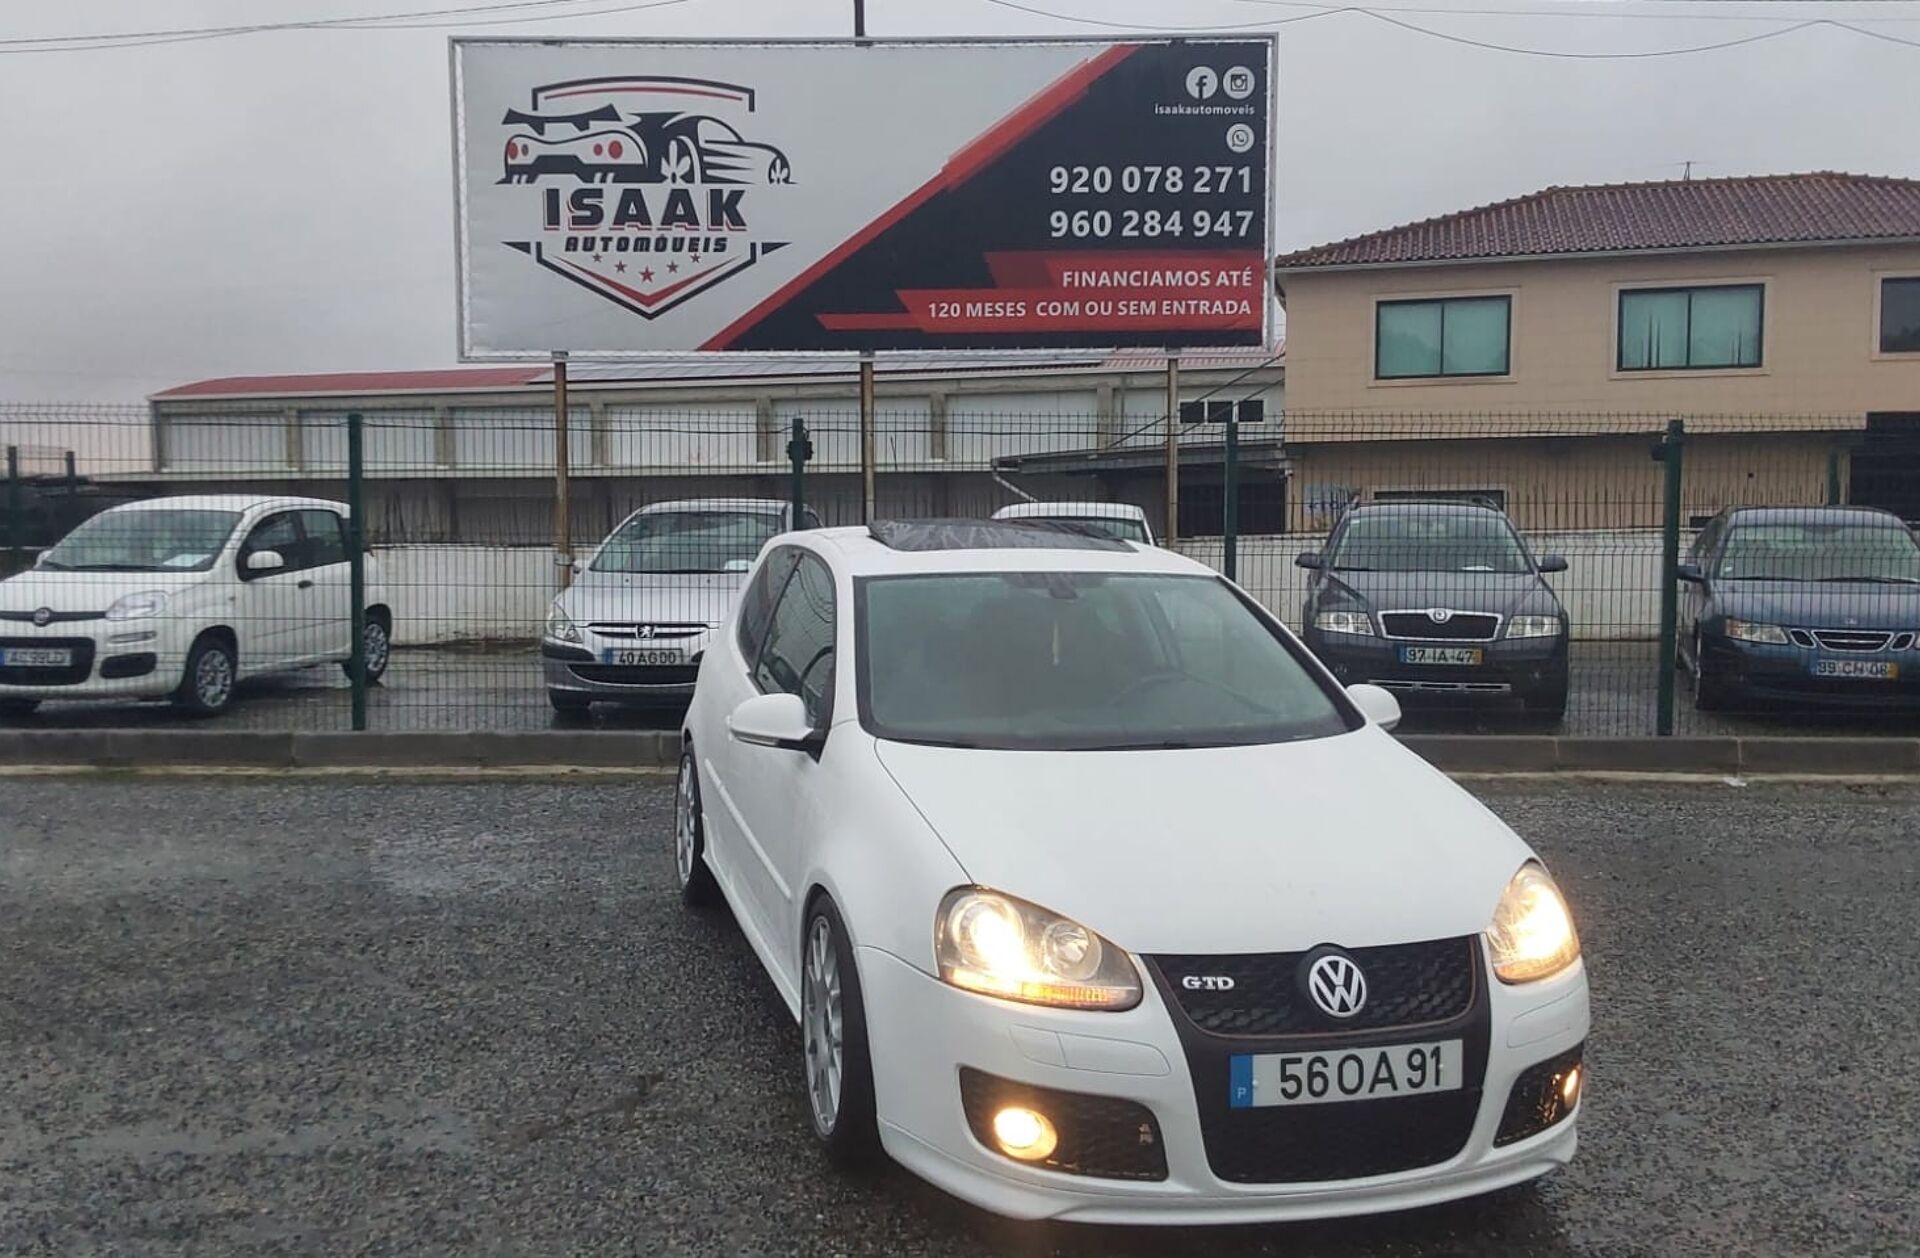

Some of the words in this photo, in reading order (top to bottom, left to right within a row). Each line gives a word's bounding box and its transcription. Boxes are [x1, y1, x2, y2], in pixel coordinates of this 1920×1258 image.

[1154, 104, 1255, 115] isaakautomoveis
[1049, 166, 1112, 193] 920
[1121, 166, 1183, 193] 078
[1193, 166, 1251, 193] 271
[543, 188, 748, 231] ISAAK
[1050, 210, 1112, 237] 960
[1121, 210, 1183, 237] 284
[1192, 210, 1254, 237] 947
[1062, 271, 1211, 287] FINANCIAMOS
[1215, 267, 1252, 286] ATÉ
[928, 303, 961, 318] 120
[966, 302, 1026, 317] MESES
[1036, 301, 1080, 316] COM
[1085, 300, 1113, 316] OU
[1118, 300, 1156, 315] SEM
[1162, 299, 1251, 315] ENTRADA
[1182, 976, 1235, 990] GTD
